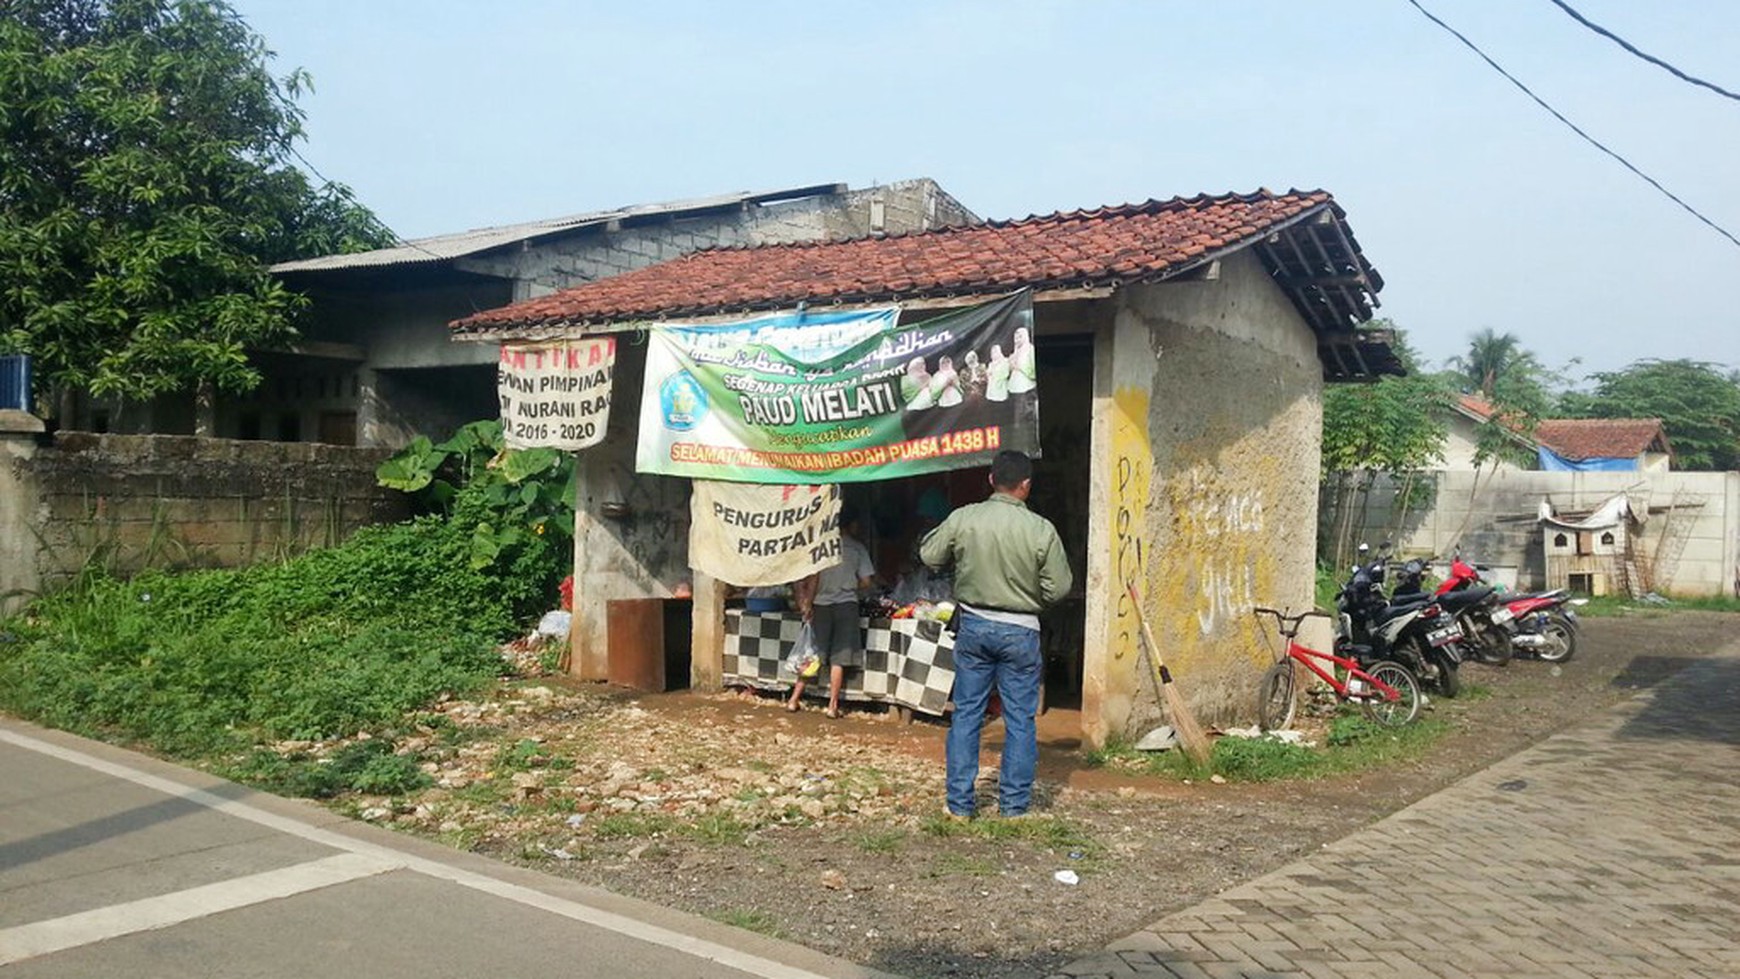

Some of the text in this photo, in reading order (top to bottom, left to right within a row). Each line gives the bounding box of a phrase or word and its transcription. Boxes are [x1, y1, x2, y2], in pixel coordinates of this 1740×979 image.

[723, 374, 785, 394] SEGENAP
[518, 400, 575, 418] NURANI
[739, 382, 897, 425] PAUD MELATI
[516, 423, 547, 439] 2016
[560, 422, 595, 439] 2020
[671, 443, 734, 464] SELAMAT
[828, 446, 886, 468] IBADAH
[889, 436, 939, 461] PUASA
[941, 429, 983, 454] 1438
[985, 425, 1000, 448] H
[713, 496, 821, 528] PENGURUS
[738, 526, 814, 556] PARTAI
[809, 538, 841, 565] TAH
